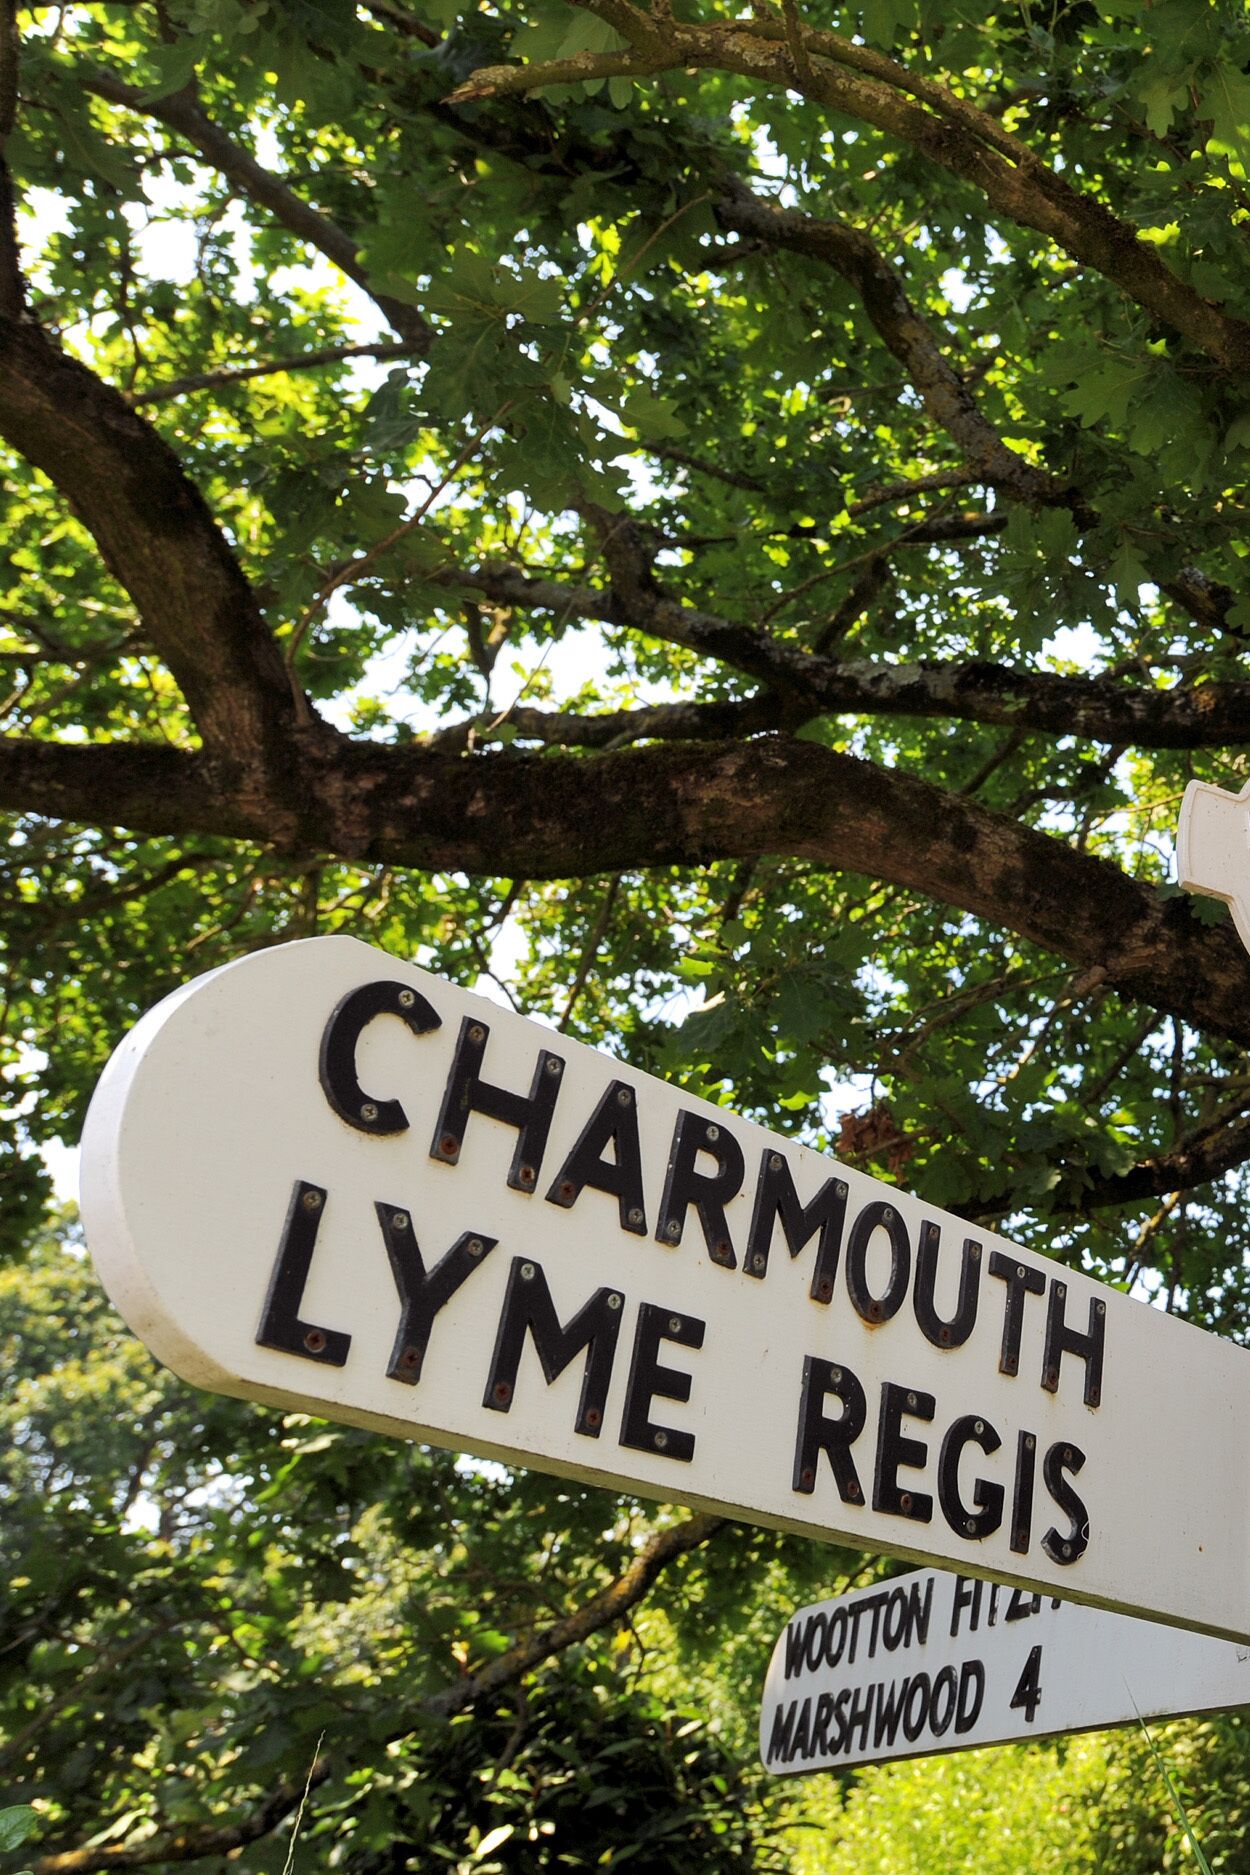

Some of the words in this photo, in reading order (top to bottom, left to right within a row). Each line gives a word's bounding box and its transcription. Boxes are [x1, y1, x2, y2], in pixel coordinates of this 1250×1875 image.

[319, 980, 1107, 1407] CHARMOUTH
[255, 1180, 706, 1462] LYME
[792, 1354, 1091, 1566] REGIS
[766, 1658, 985, 1766] MARSHWOOD
[1009, 1645, 1044, 1722] 4
[784, 1577, 935, 1680] WOOTTON
